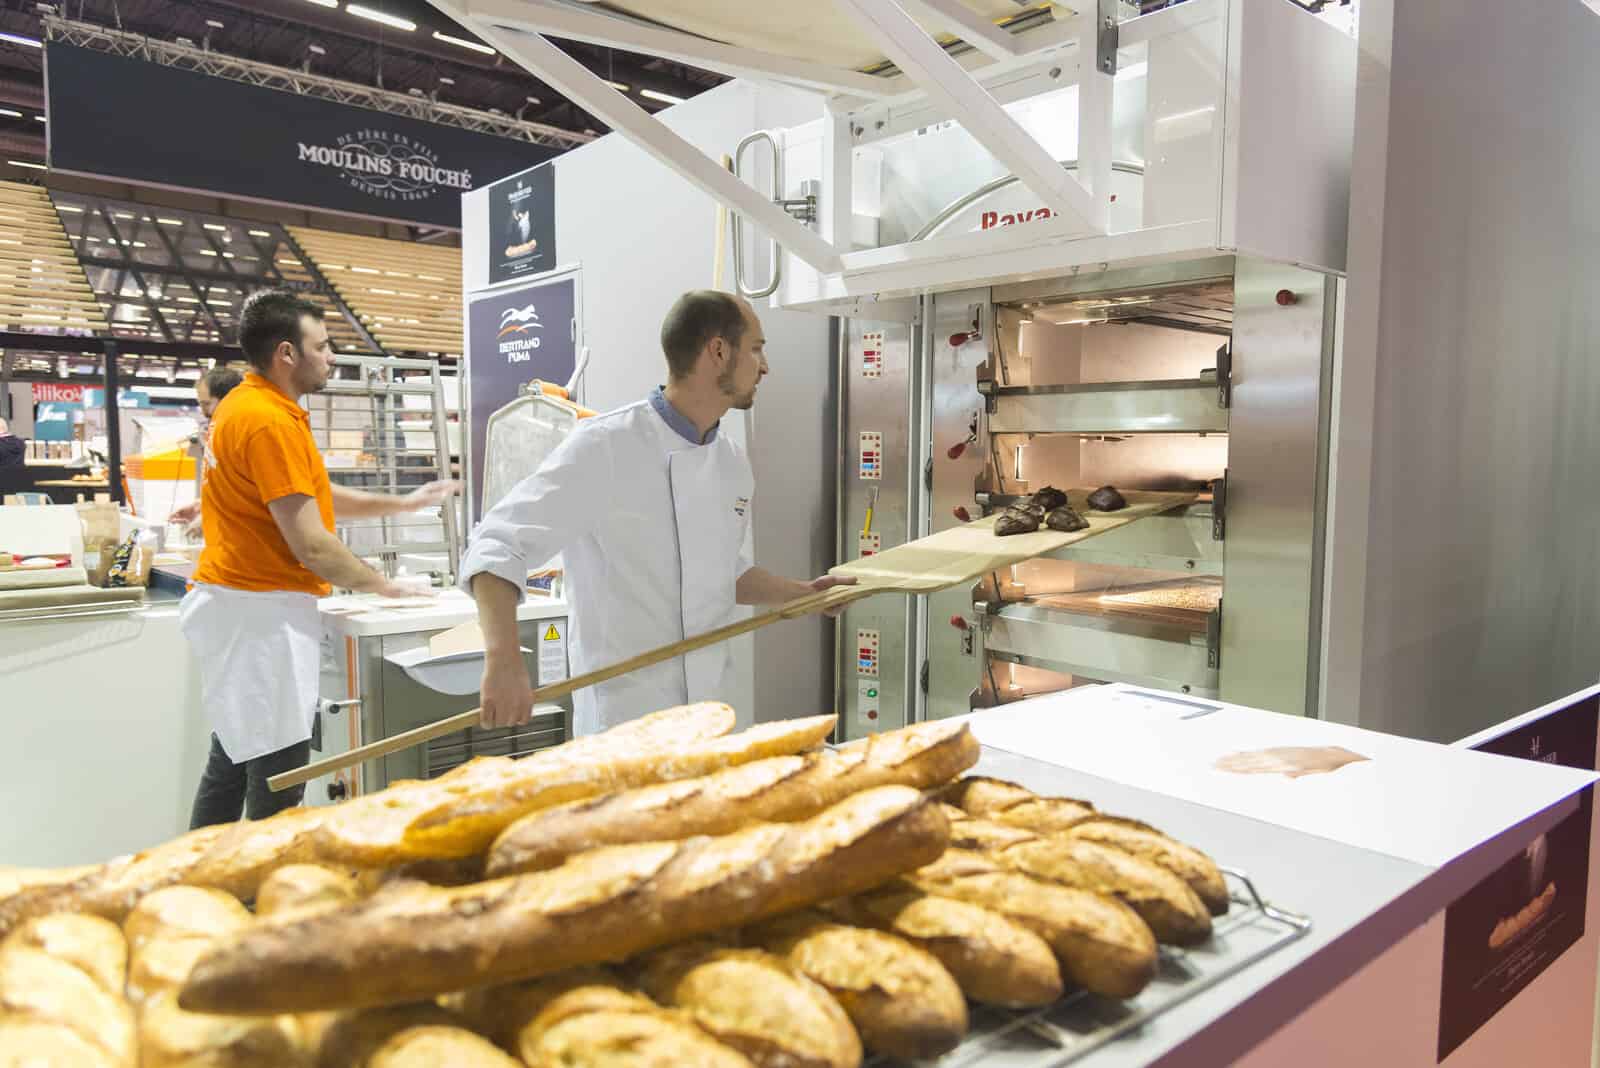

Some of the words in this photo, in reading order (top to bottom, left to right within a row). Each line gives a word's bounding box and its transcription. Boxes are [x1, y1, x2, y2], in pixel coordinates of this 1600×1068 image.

[336, 133, 352, 146] DE
[297, 142, 393, 176] MOULINS
[398, 161, 473, 190] FOUCHÉ
[350, 178, 396, 200] DEPUIS
[499, 337, 541, 353] BERTRAND
[507, 350, 531, 364] PUMA
